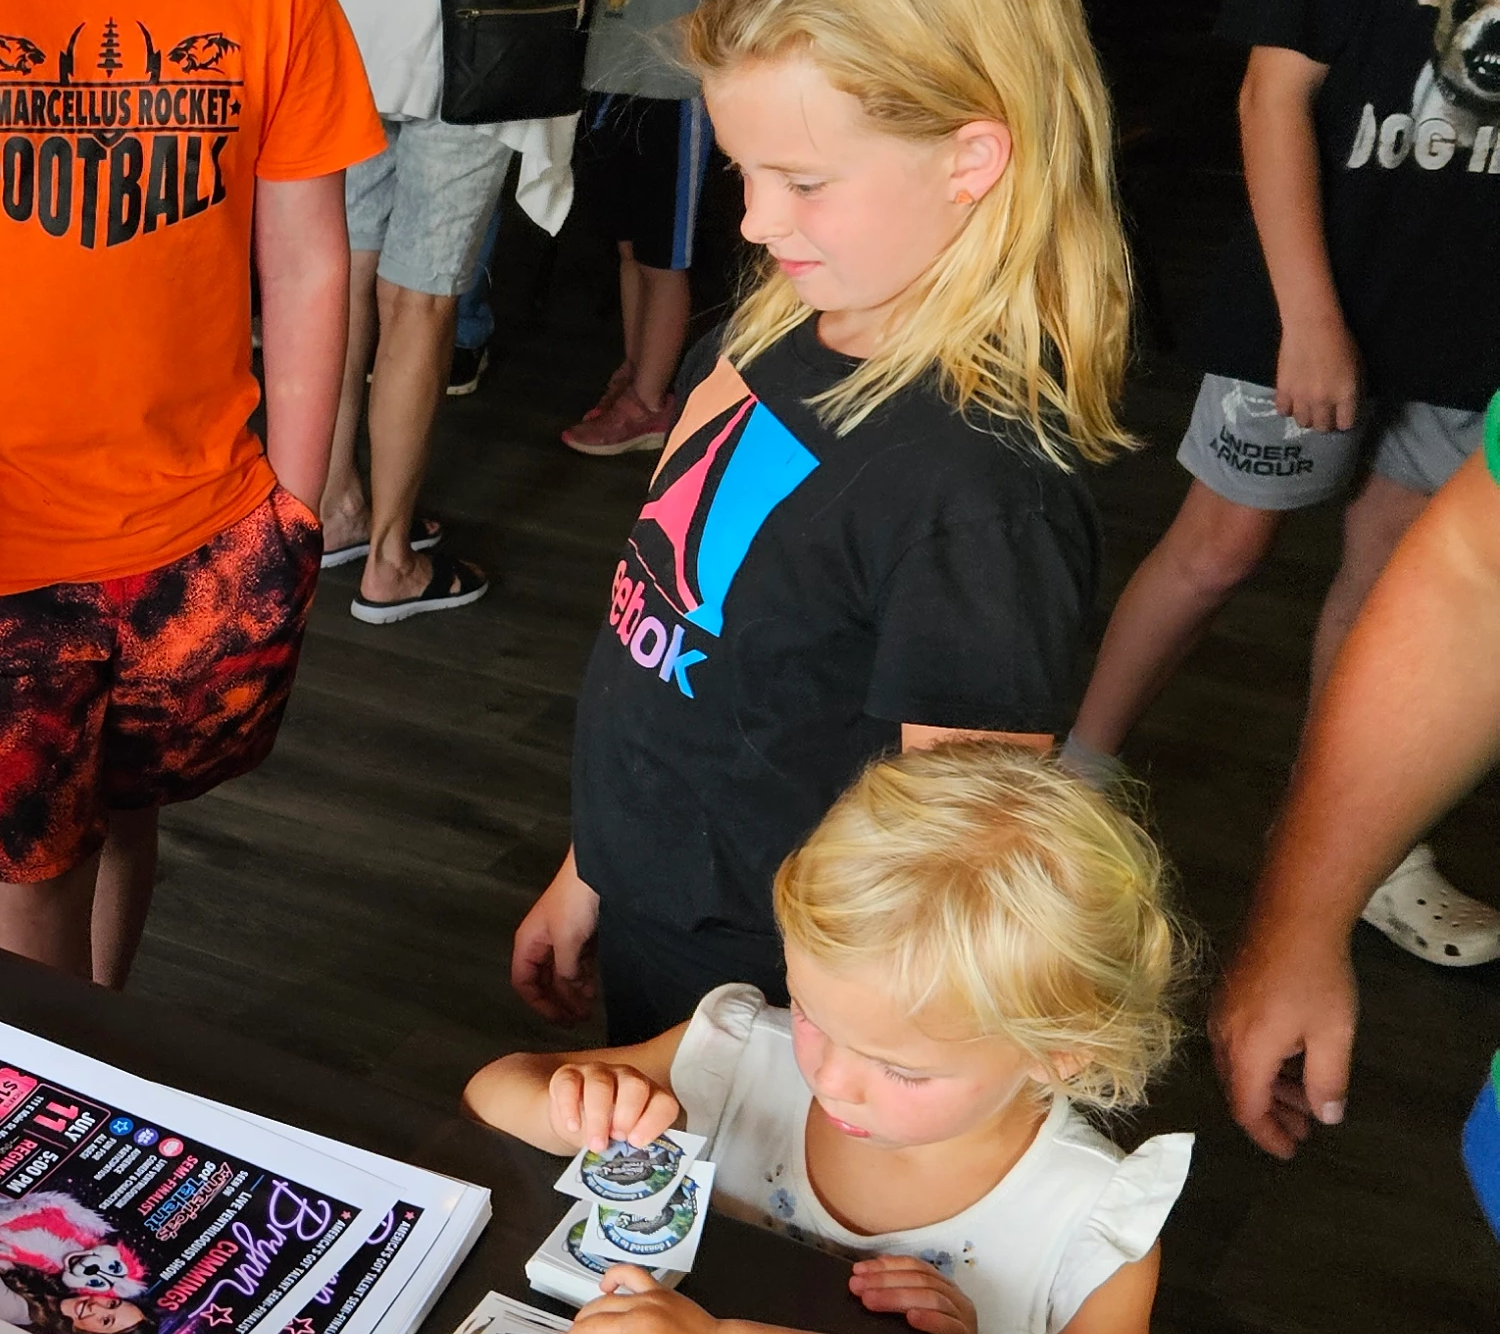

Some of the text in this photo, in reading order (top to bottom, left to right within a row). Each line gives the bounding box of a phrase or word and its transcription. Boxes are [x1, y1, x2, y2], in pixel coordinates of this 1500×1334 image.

[137, 88, 231, 126] ROCKET
[1209, 437, 1314, 477] ARMOUR
[1219, 424, 1303, 461] UNDER
[609, 559, 708, 699] eebok
[33, 1102, 79, 1132] 11
[64, 1112, 96, 1143] JULY
[93, 1133, 107, 1144] ALL
[6, 1151, 59, 1193] 5:00 PM
[138, 1155, 198, 1216] SEMI-FINALIST
[222, 1170, 248, 1197] SEEN ON
[144, 1161, 216, 1231] got Talent
[155, 1162, 234, 1241] America's
[159, 1191, 252, 1281] LIVE VENTRILOQUIST SHOW
[188, 1180, 325, 1318] Brynn
[380, 1221, 411, 1258] AMERICA'S
[158, 1241, 238, 1311] CUMMINGS
[235, 1219, 346, 1334] AMERICA'S GOT TALENT SEMI-FINALIST
[353, 1272, 377, 1298] TALENT
[371, 1258, 387, 1273] GOT
